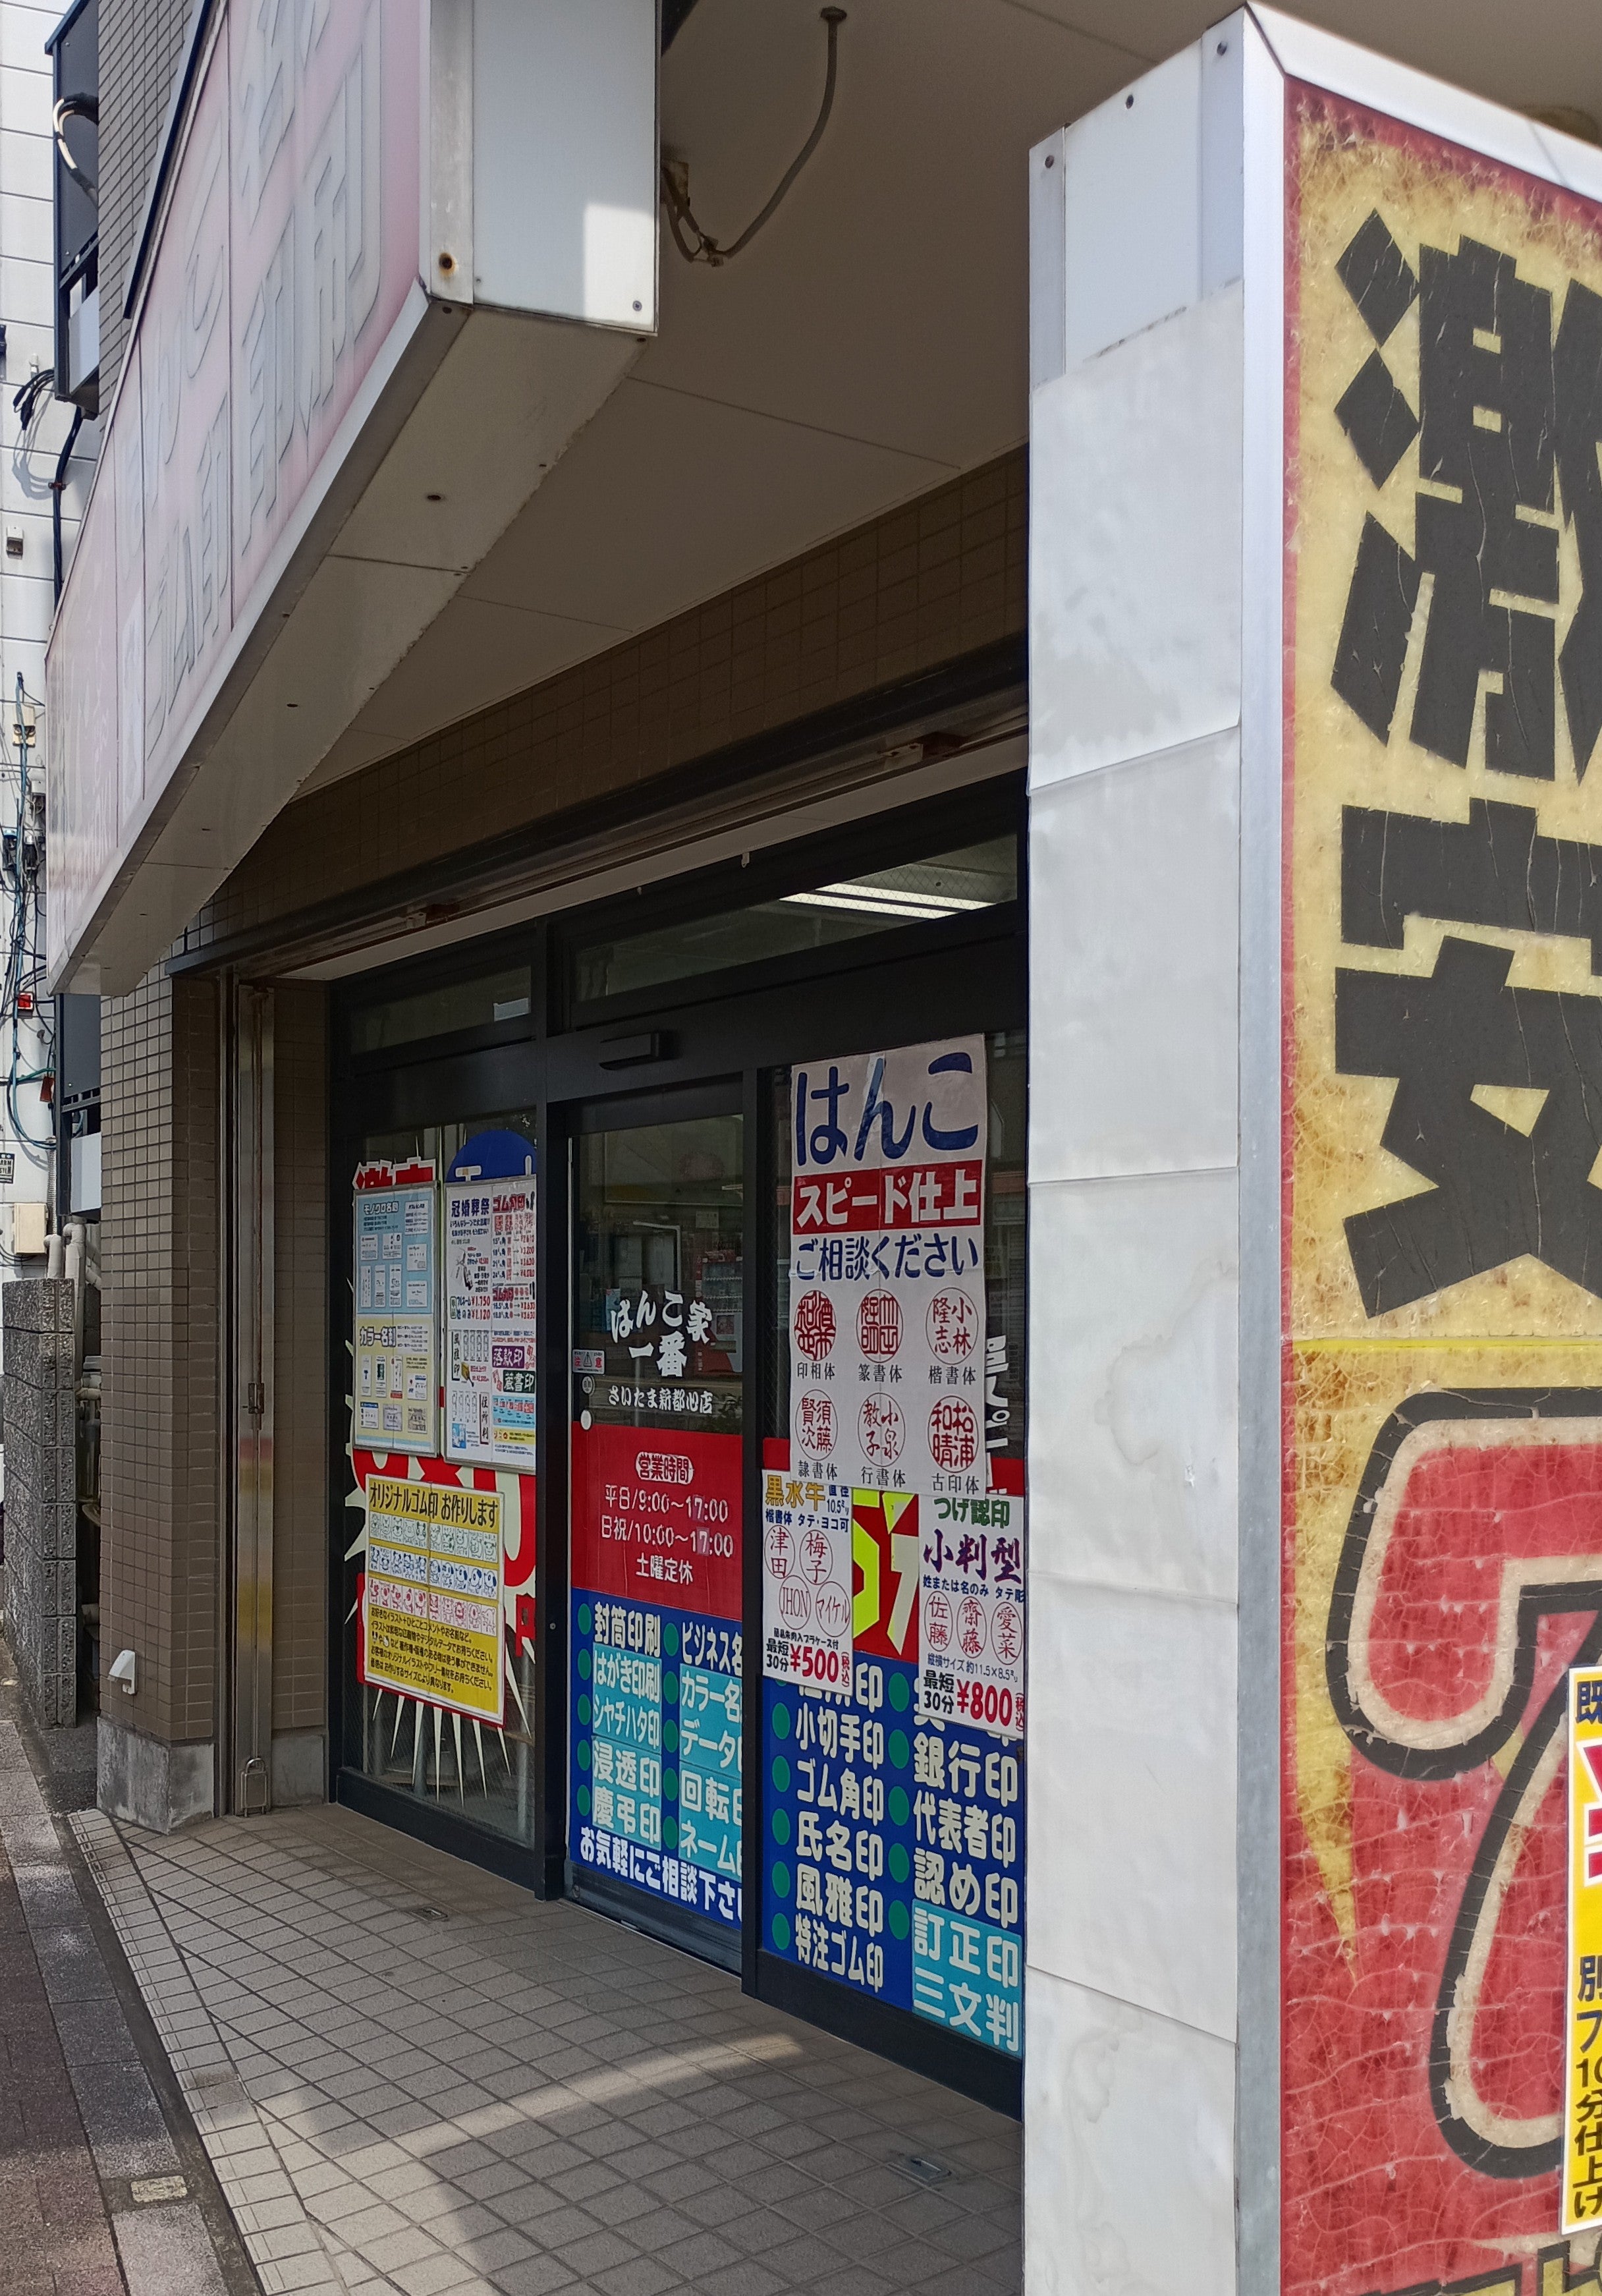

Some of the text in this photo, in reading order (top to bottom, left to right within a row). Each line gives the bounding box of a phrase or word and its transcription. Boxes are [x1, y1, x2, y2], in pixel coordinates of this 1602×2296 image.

[796, 1052, 978, 1166] はんこ
[796, 1169, 978, 1228] スピード仕上
[796, 1233, 978, 1281] ご相談ください
[611, 1290, 713, 1344] はんこ家
[629, 1330, 686, 1377] 一番
[797, 1362, 835, 1380] 印相体
[858, 1364, 902, 1383] 篆書体
[928, 1366, 976, 1385] 楷書体
[609, 1386, 713, 1415] さいたま新都心店
[638, 1452, 690, 1485] 営業時間
[765, 1474, 825, 1511] 黒水牛
[861, 1467, 906, 1488] 行書体
[931, 1473, 979, 1494] 古印体
[370, 1482, 498, 1528] オリジナルゴム印 お作りします
[765, 1508, 792, 1526] 楷書体
[934, 1498, 1010, 1528] つげ認印
[636, 1554, 693, 1584] 土曜定休
[770, 1527, 789, 1577] 津田
[805, 1532, 827, 1583] 梅子
[923, 1528, 1021, 1584] 小判型
[781, 1586, 808, 1617] JHON
[817, 1595, 850, 1623] マイケル
[923, 1574, 989, 1597] 姓または名のみ
[595, 1602, 660, 1658] 封筒印刷
[929, 1596, 948, 1646] 佐藤
[766, 1638, 788, 1656] 最短
[766, 1654, 788, 1672] 30分
[790, 1643, 839, 1683] ¥500
[594, 1650, 659, 1703] はがき印刷
[682, 1670, 742, 1723] カラー名
[924, 1669, 954, 1693] 最短
[924, 1691, 954, 1714] 30分
[956, 1679, 1012, 1727] ¥800
[681, 1719, 742, 1773] データ
[796, 1702, 884, 1770] 小切手印
[594, 1741, 659, 1798] 浸透印
[796, 1758, 884, 1826] ゴム角印
[914, 1731, 1018, 1806] 銀行印
[594, 1786, 742, 1877] 慶弔印 ネーム
[796, 1812, 883, 1881] 氏名印
[913, 1790, 1016, 1868] 代表者印
[796, 1868, 883, 1938] 風雅印
[914, 1848, 1018, 1928] 認め印
[795, 1915, 883, 1992] 特注ゴム印
[914, 1908, 1018, 1988] 訂正印
[914, 1968, 1019, 2052] 三文判
